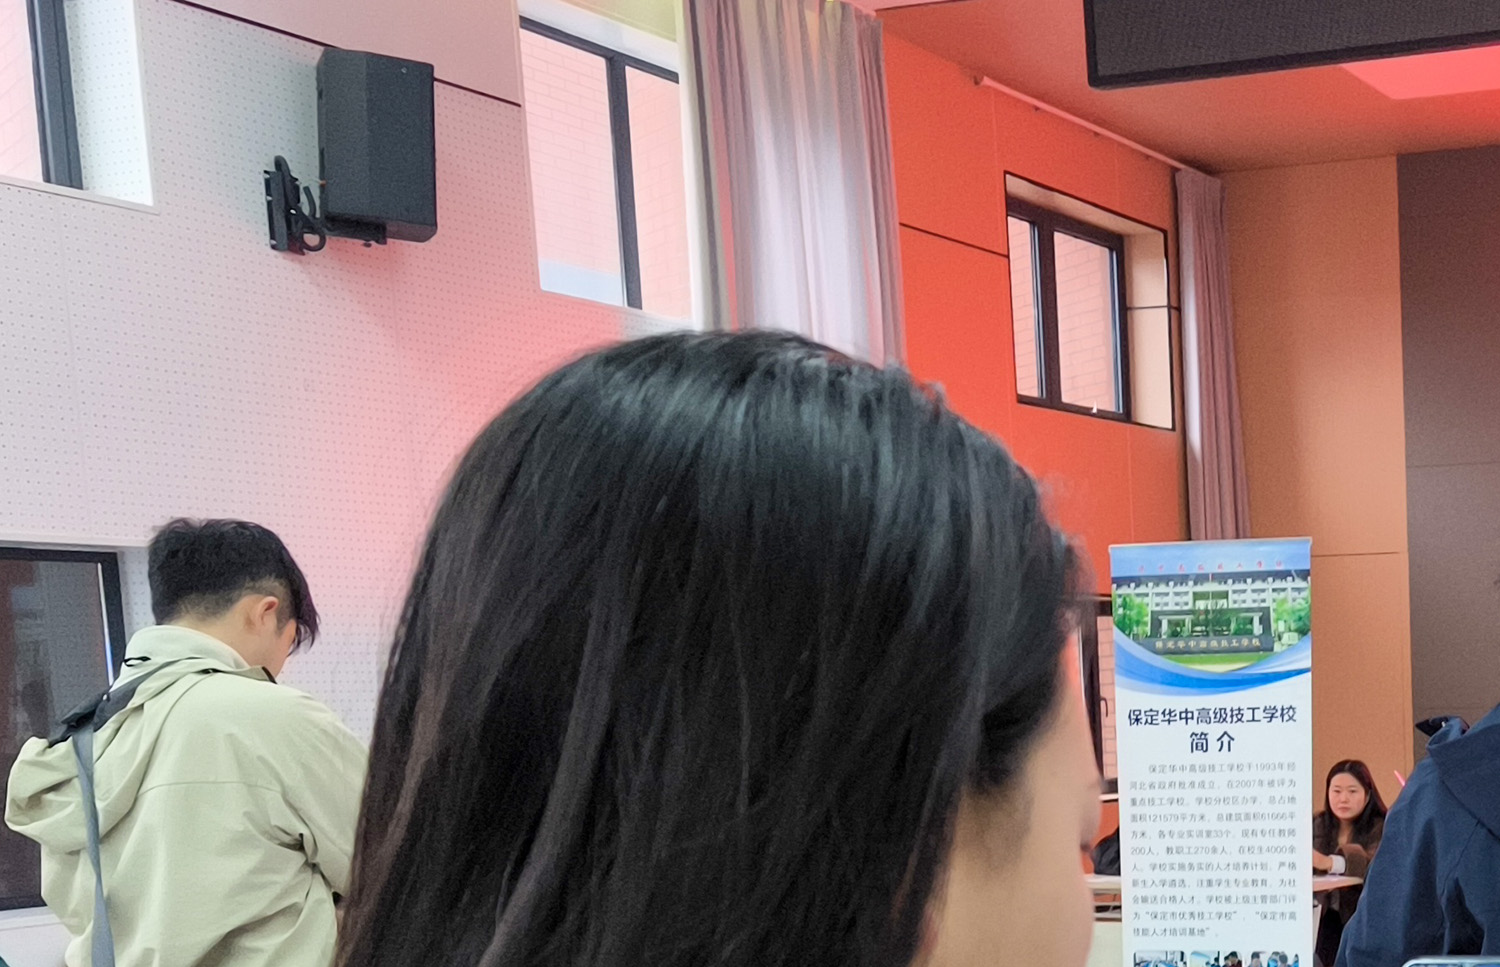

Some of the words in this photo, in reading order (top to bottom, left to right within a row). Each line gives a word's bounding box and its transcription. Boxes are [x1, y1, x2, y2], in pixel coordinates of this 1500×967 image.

[1128, 704, 1297, 727] 保定华中高级技工学校
